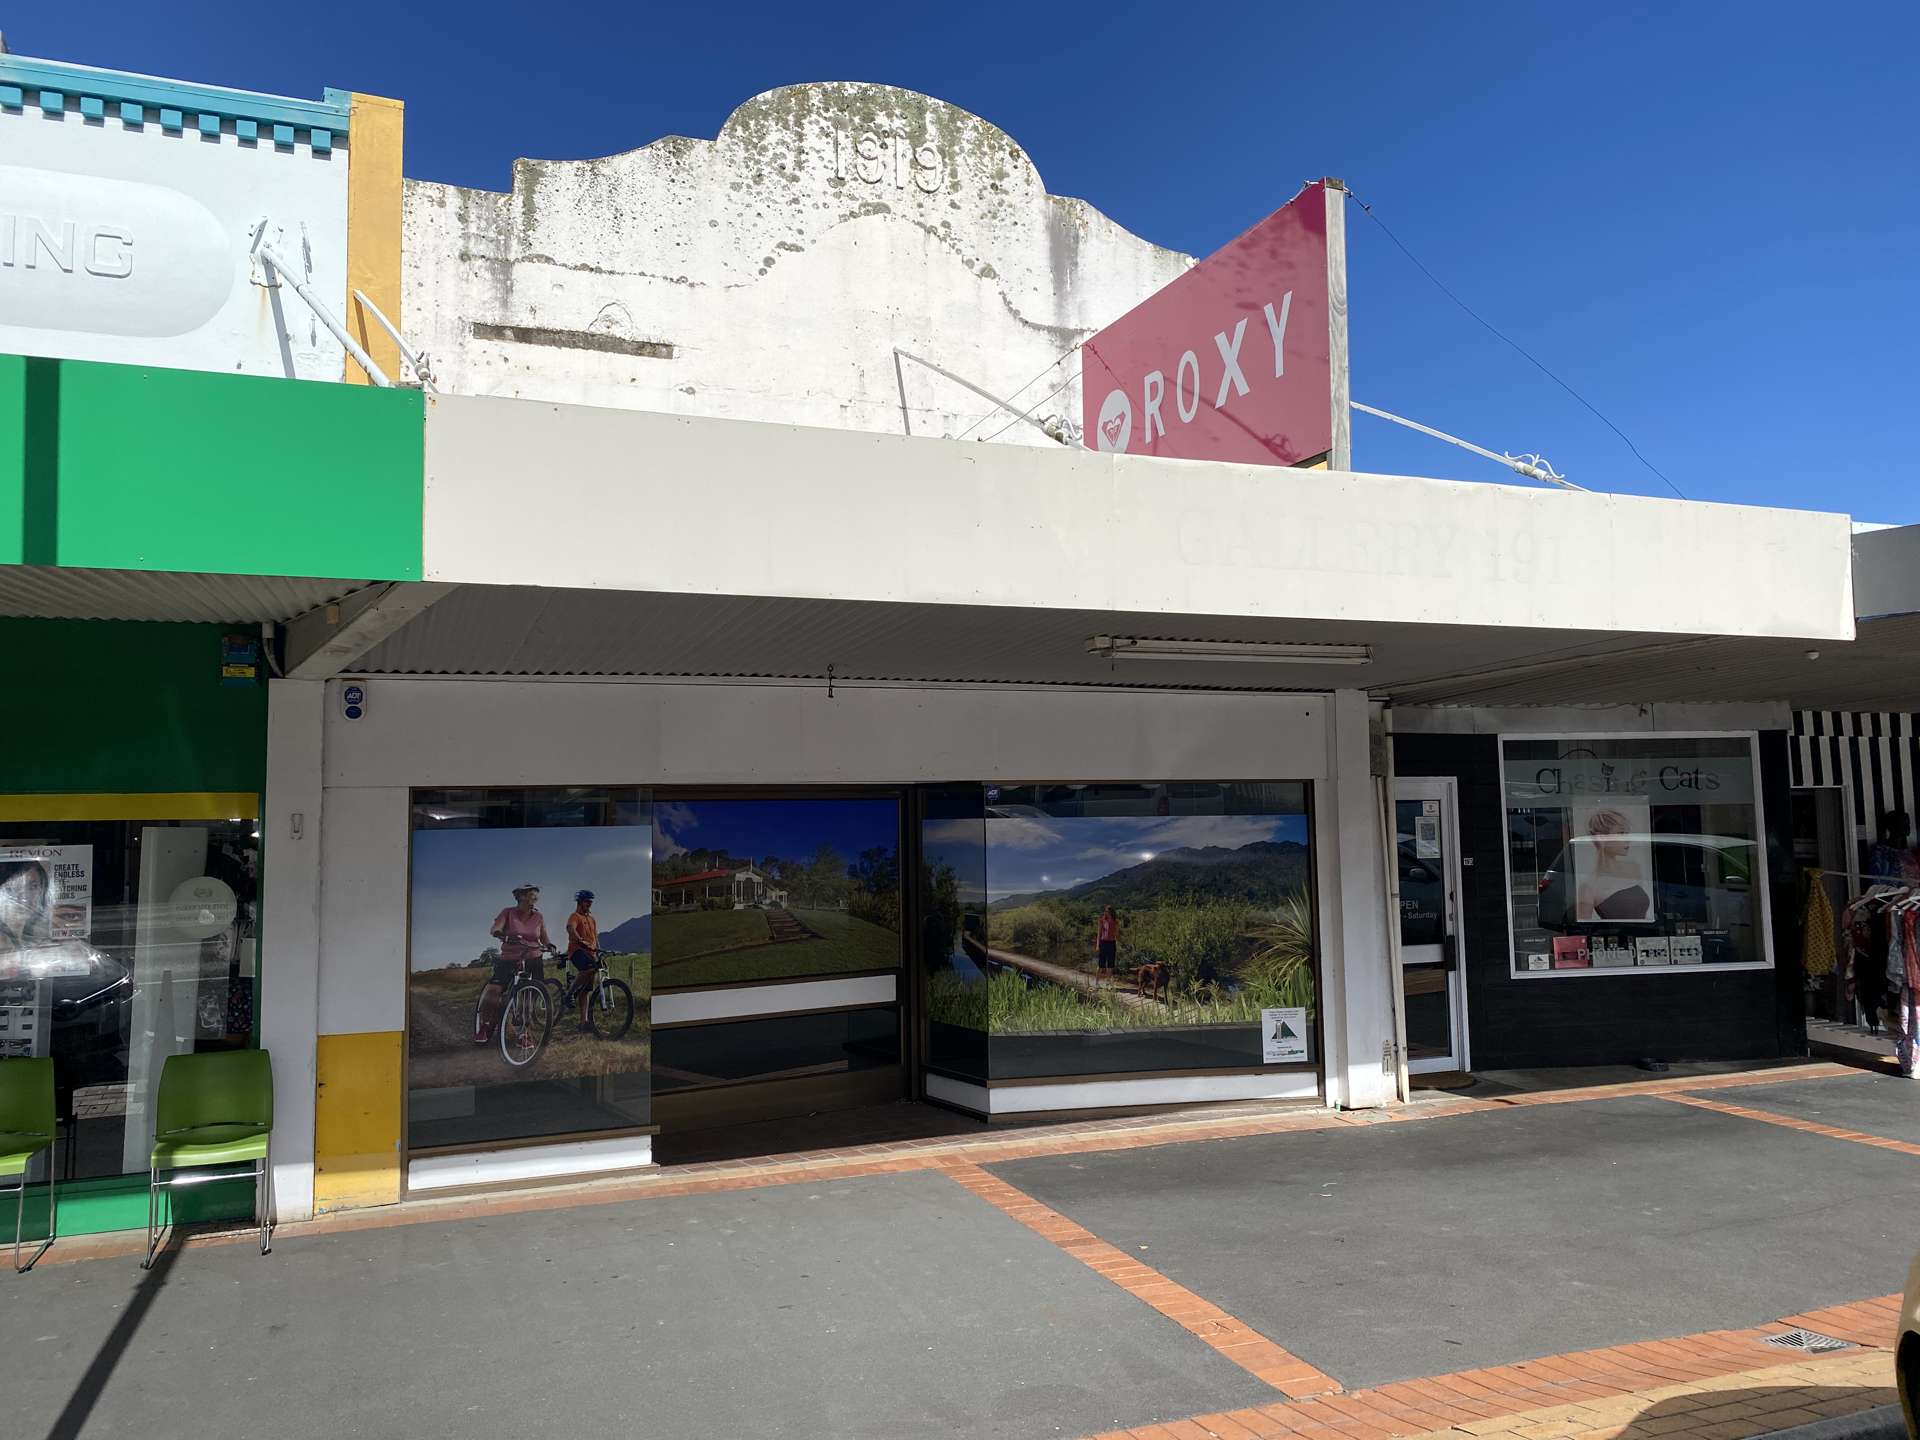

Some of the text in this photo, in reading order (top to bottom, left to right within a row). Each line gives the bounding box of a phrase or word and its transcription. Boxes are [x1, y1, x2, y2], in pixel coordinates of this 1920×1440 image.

[835, 122, 944, 194] 1919
[1143, 290, 1293, 444] ROXY
[1658, 766, 1721, 792] Cats
[9, 848, 64, 858] REVLON
[54, 863, 80, 871] CREATE
[55, 884, 88, 892] TCHING
[1400, 899, 1418, 909] PEN
[1407, 911, 1438, 920] Saturday
